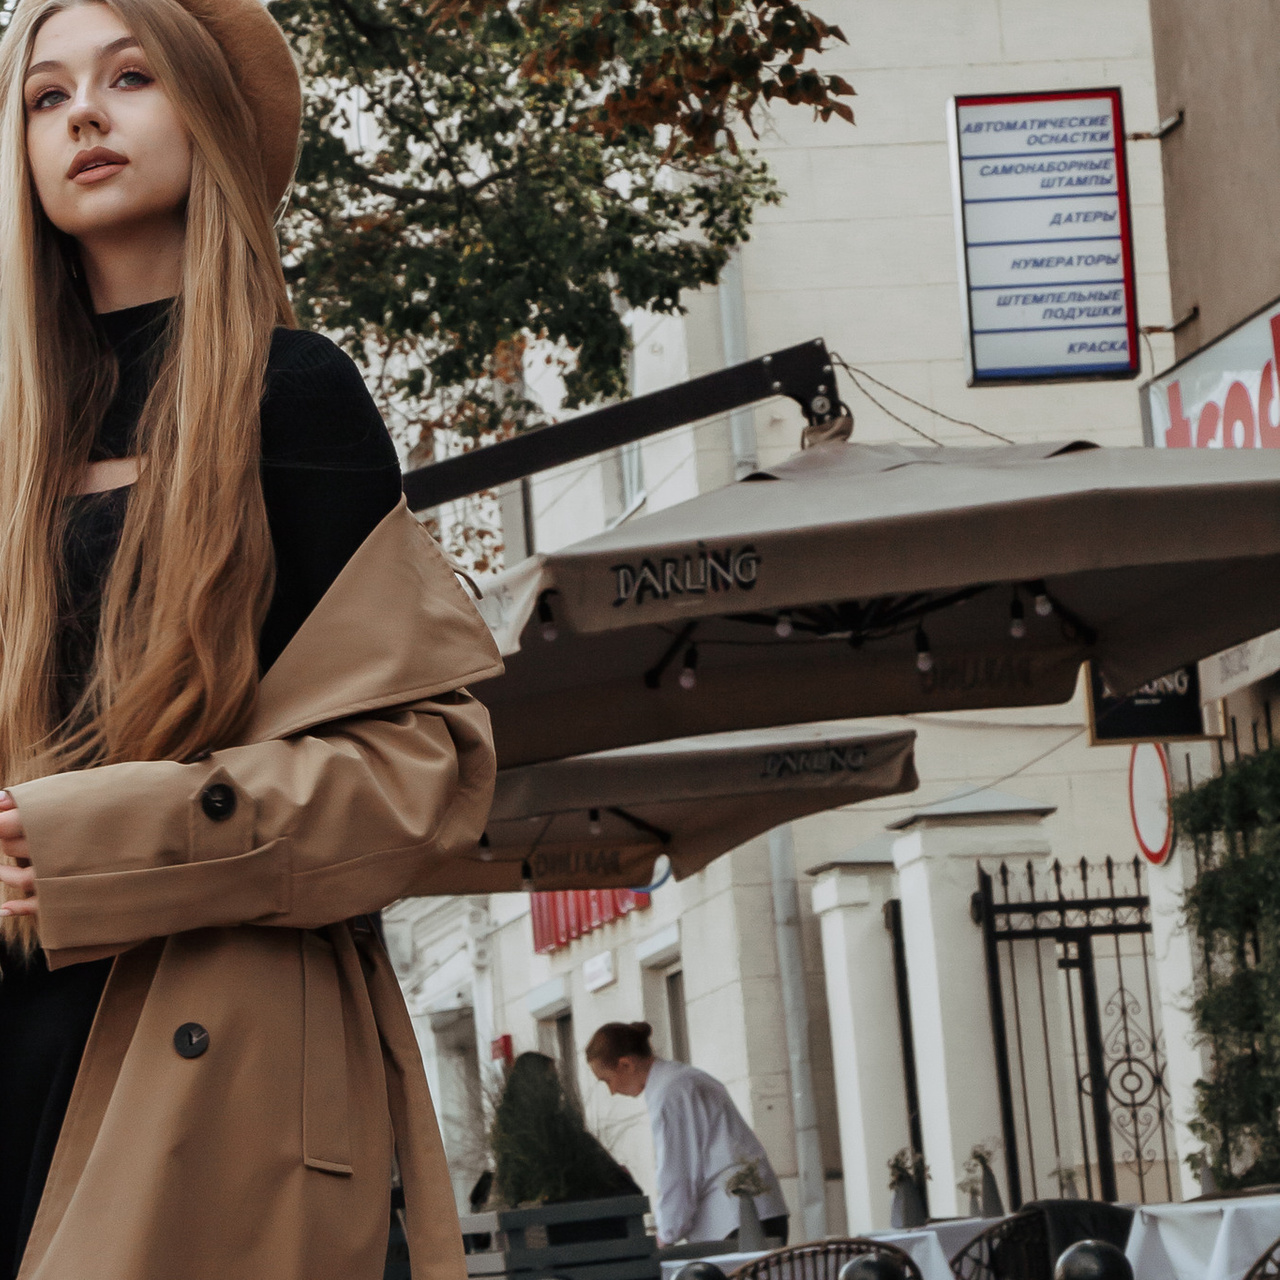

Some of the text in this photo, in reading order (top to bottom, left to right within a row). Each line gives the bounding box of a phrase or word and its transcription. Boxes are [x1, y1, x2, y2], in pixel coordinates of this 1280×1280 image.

[962, 114, 1111, 134] АВТОМАТИЧЕСКИЕ
[1026, 130, 1111, 146] ОСНАСТКИ
[979, 158, 1112, 176] САМОНАБОРНЫЕ
[1040, 174, 1114, 189] ШТАМПЫ
[1049, 210, 1117, 227] ДАТЕРЫ
[1011, 254, 1120, 270] НУМЕРАТОРЫ
[996, 289, 1123, 306] ШТЕМПЕЛЬНЫЕ
[1042, 305, 1123, 321] ПОДУШКИ
[1067, 340, 1128, 354] КРАСКА
[610, 540, 761, 607] DARLING
